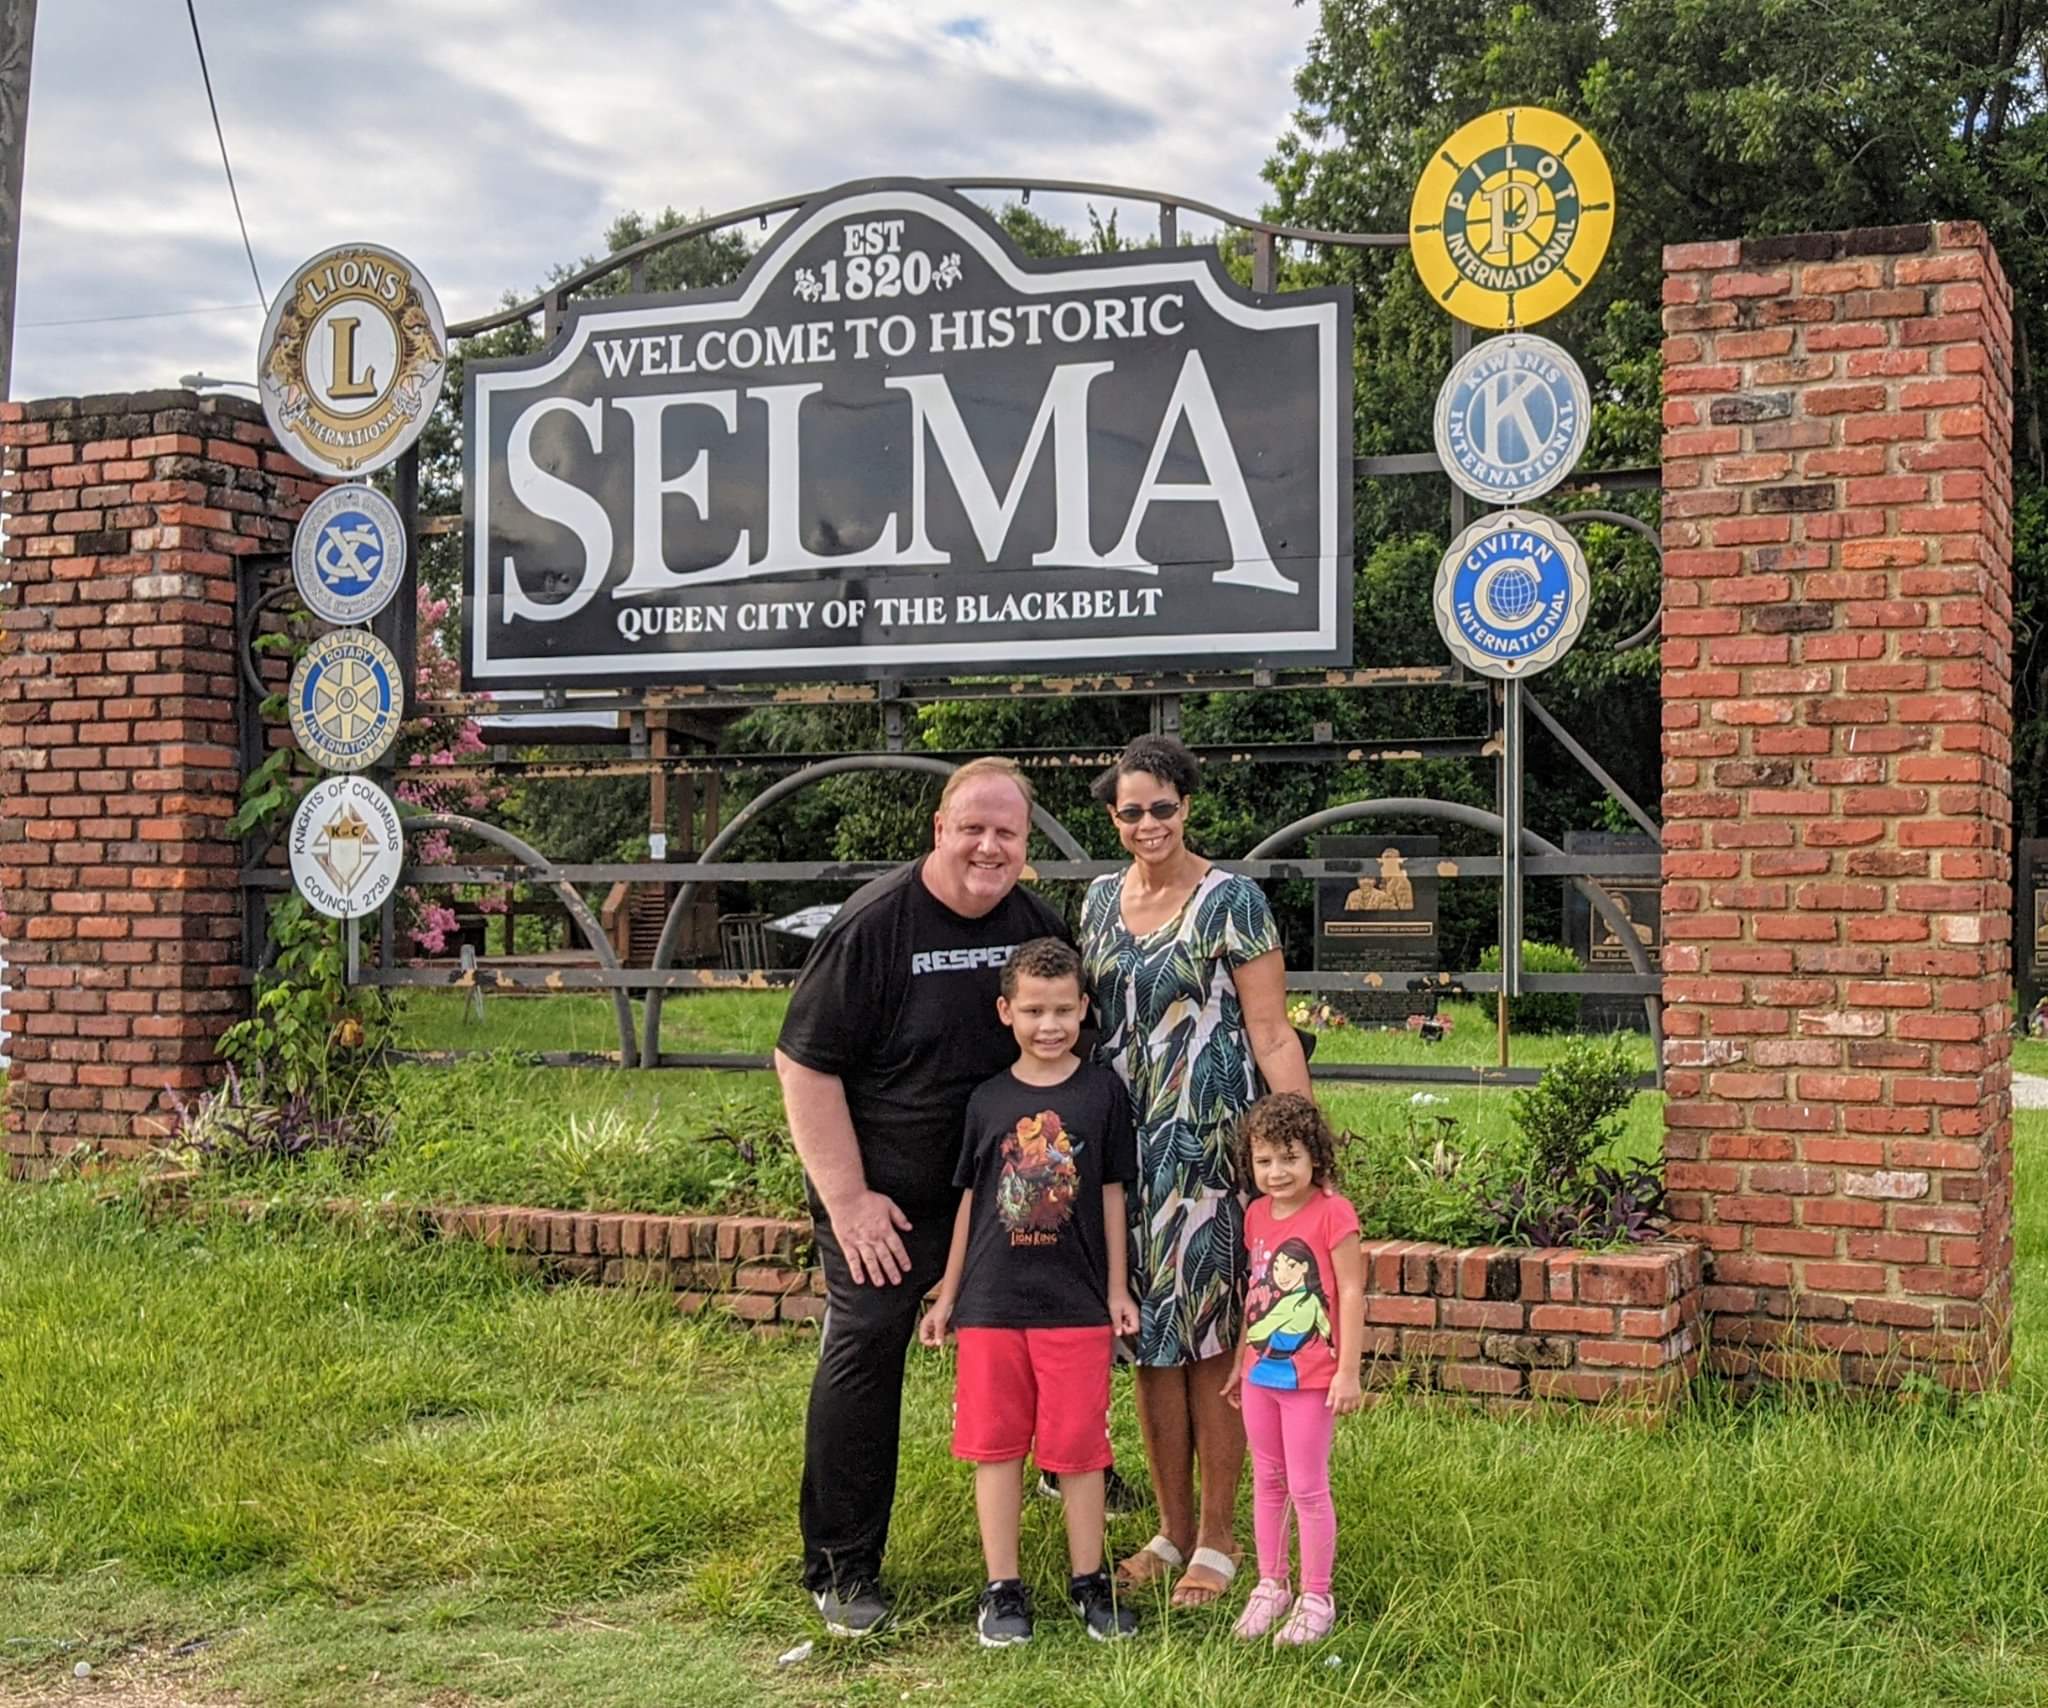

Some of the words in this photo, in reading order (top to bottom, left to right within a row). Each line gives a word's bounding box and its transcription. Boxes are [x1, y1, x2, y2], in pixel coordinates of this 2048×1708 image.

[1448, 146, 1576, 212] PILOT
[843, 219, 905, 257] EST
[1446, 218, 1576, 290] INTERNATIONAL
[304, 260, 401, 303] LIONS
[820, 250, 932, 303] 1820
[326, 316, 378, 400] L
[592, 320, 836, 381] WELCOME
[845, 313, 918, 360] TO
[929, 293, 1186, 353] HISTORIC
[1464, 348, 1561, 391] KIWANIS
[1449, 399, 1574, 486] INTERNATIONAL
[502, 349, 1301, 626] SELMA
[1466, 533, 1553, 571] CIVITAN
[616, 604, 728, 642] QUEEN
[736, 600, 815, 632] CITY
[821, 599, 866, 629] OF
[874, 597, 948, 626] THE
[955, 588, 1163, 623] BLACKBELT
[1457, 588, 1566, 653] INTERNATIONAL
[325, 645, 372, 663] ROTARY
[305, 718, 386, 754] INTERNATIONAL
[294, 791, 325, 855] KNIGHTS
[327, 781, 347, 797] OF
[352, 782, 399, 852] COLUMBUS
[303, 875, 358, 912] COUNCIL
[362, 873, 391, 907] 2738
